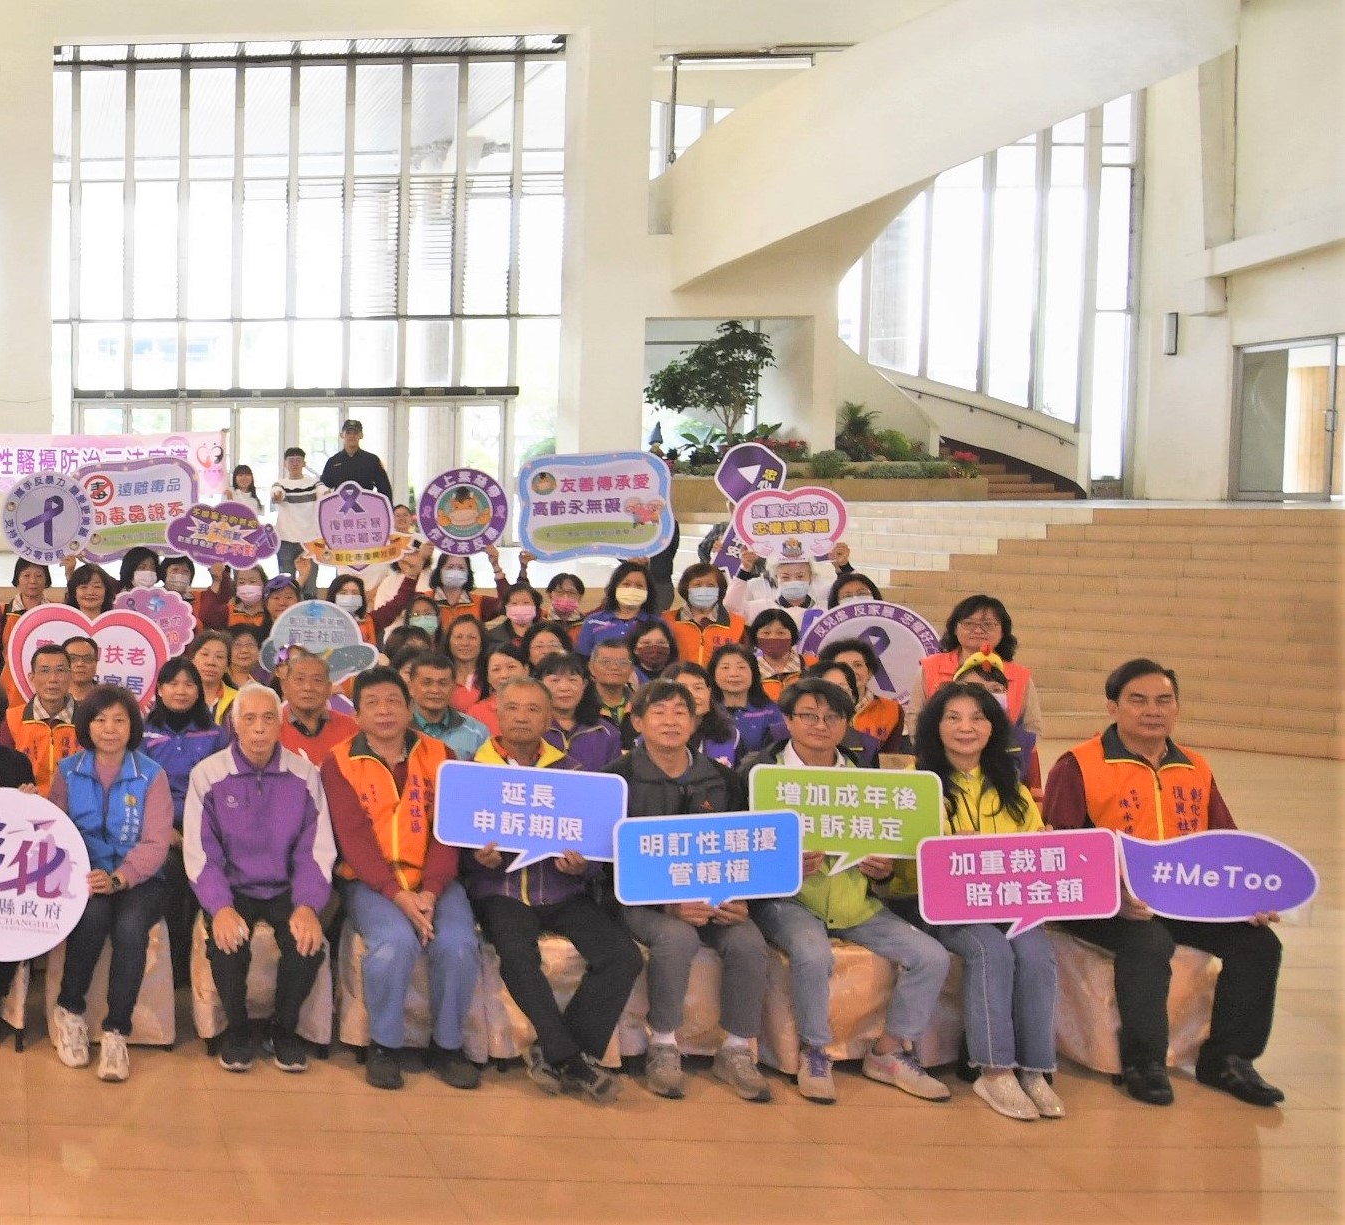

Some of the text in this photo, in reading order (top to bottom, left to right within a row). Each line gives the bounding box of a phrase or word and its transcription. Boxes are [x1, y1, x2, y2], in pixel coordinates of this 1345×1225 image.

[118, 478, 181, 497] 遠離毒品
[560, 473, 650, 493] 友善傳承愛
[94, 502, 184, 525] 向毒品說不
[532, 497, 622, 517] 高齡永無礙
[96, 645, 146, 666] 扶老
[501, 781, 555, 809] 延長
[775, 781, 918, 811] 增加成年後
[1173, 786, 1192, 835] 復興社
[473, 809, 584, 842] 申訴期限
[803, 814, 904, 843] 申訴規定
[639, 827, 778, 858] 明訂性騷擾
[668, 858, 751, 888] 管轄權
[949, 847, 1089, 877] 加重裁罰、
[1152, 861, 1282, 892] #MeToo
[965, 878, 1084, 907] 賠償金額
